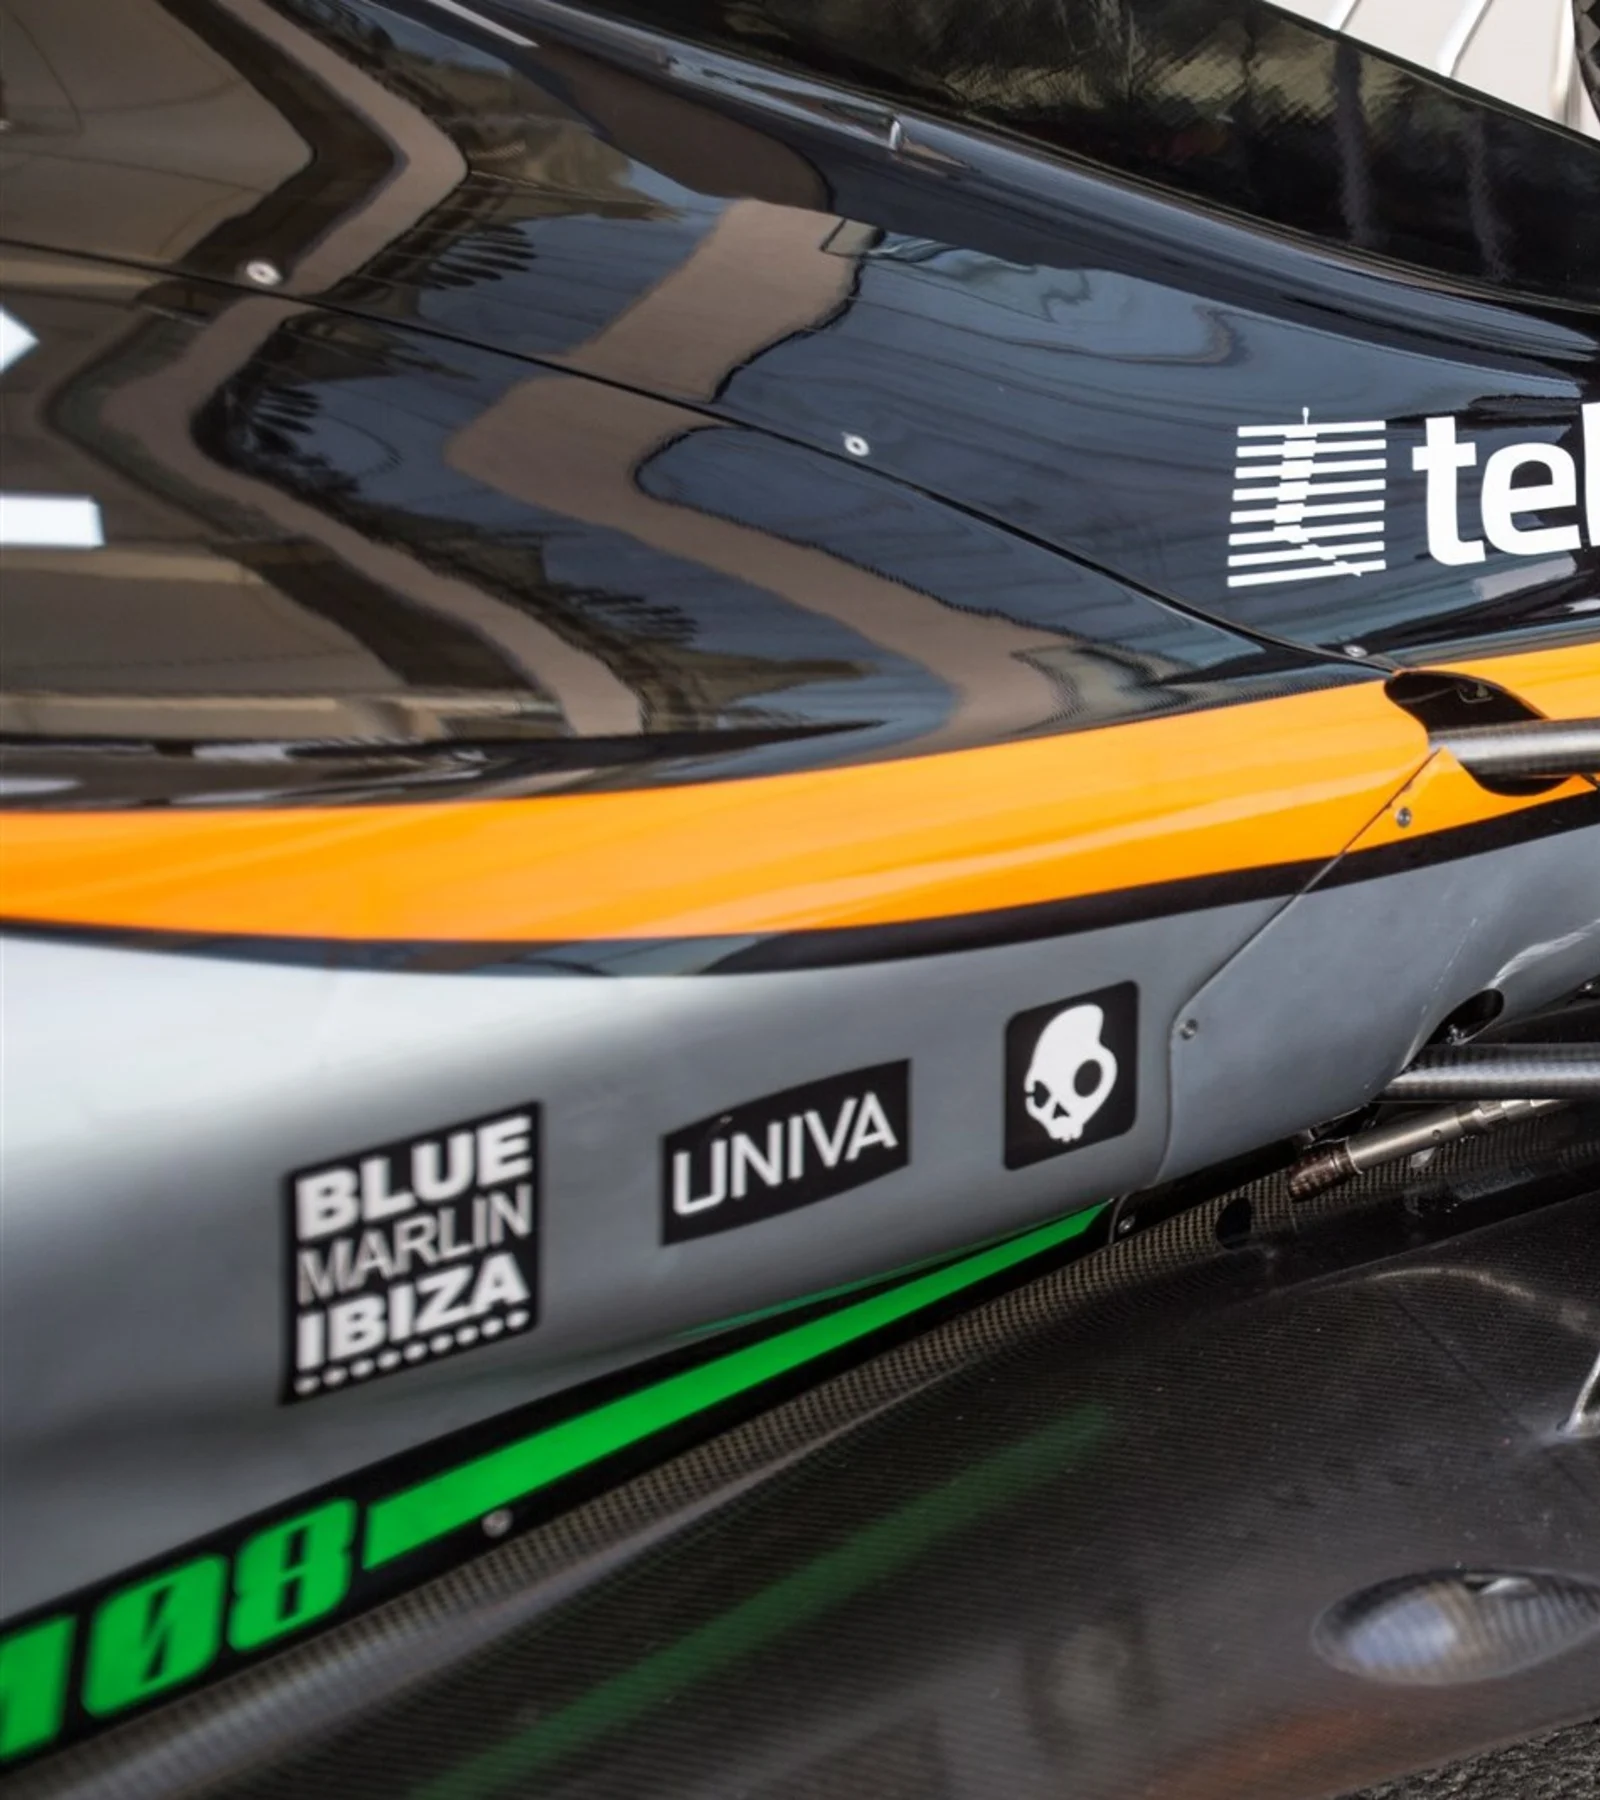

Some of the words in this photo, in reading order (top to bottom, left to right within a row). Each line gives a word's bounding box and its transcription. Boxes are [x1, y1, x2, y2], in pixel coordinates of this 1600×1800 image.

[296, 1114, 533, 1241] BLUE
[673, 1090, 899, 1216] UNIVA
[297, 1183, 533, 1305] MARLIN
[296, 1252, 533, 1373] IBIZA
